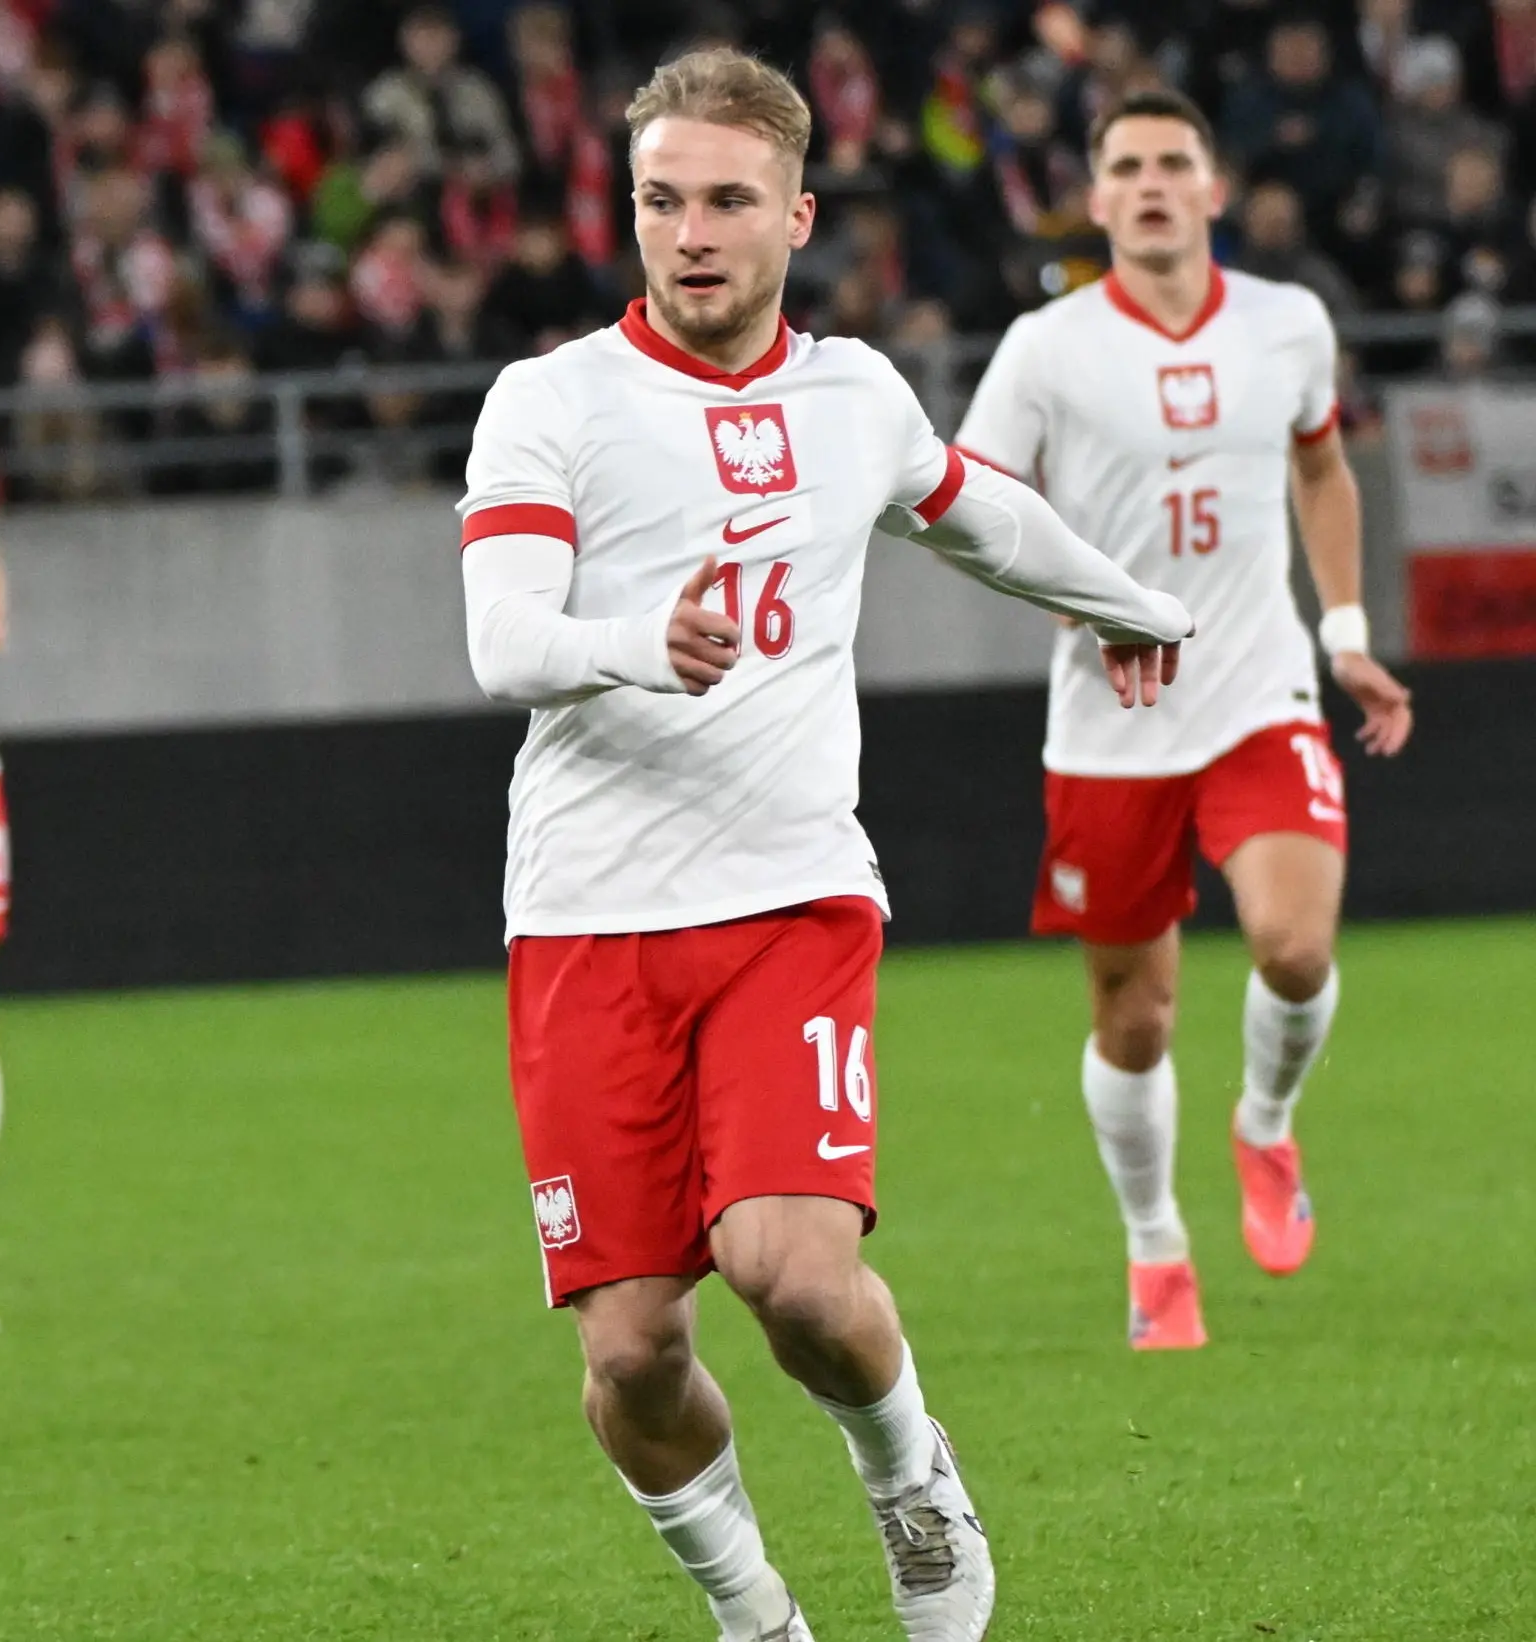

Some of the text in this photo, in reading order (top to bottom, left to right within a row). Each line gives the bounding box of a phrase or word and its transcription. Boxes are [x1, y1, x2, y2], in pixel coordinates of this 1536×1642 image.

[1160, 488, 1222, 558] 15
[711, 561, 796, 660] 16
[803, 1015, 871, 1123] 16
